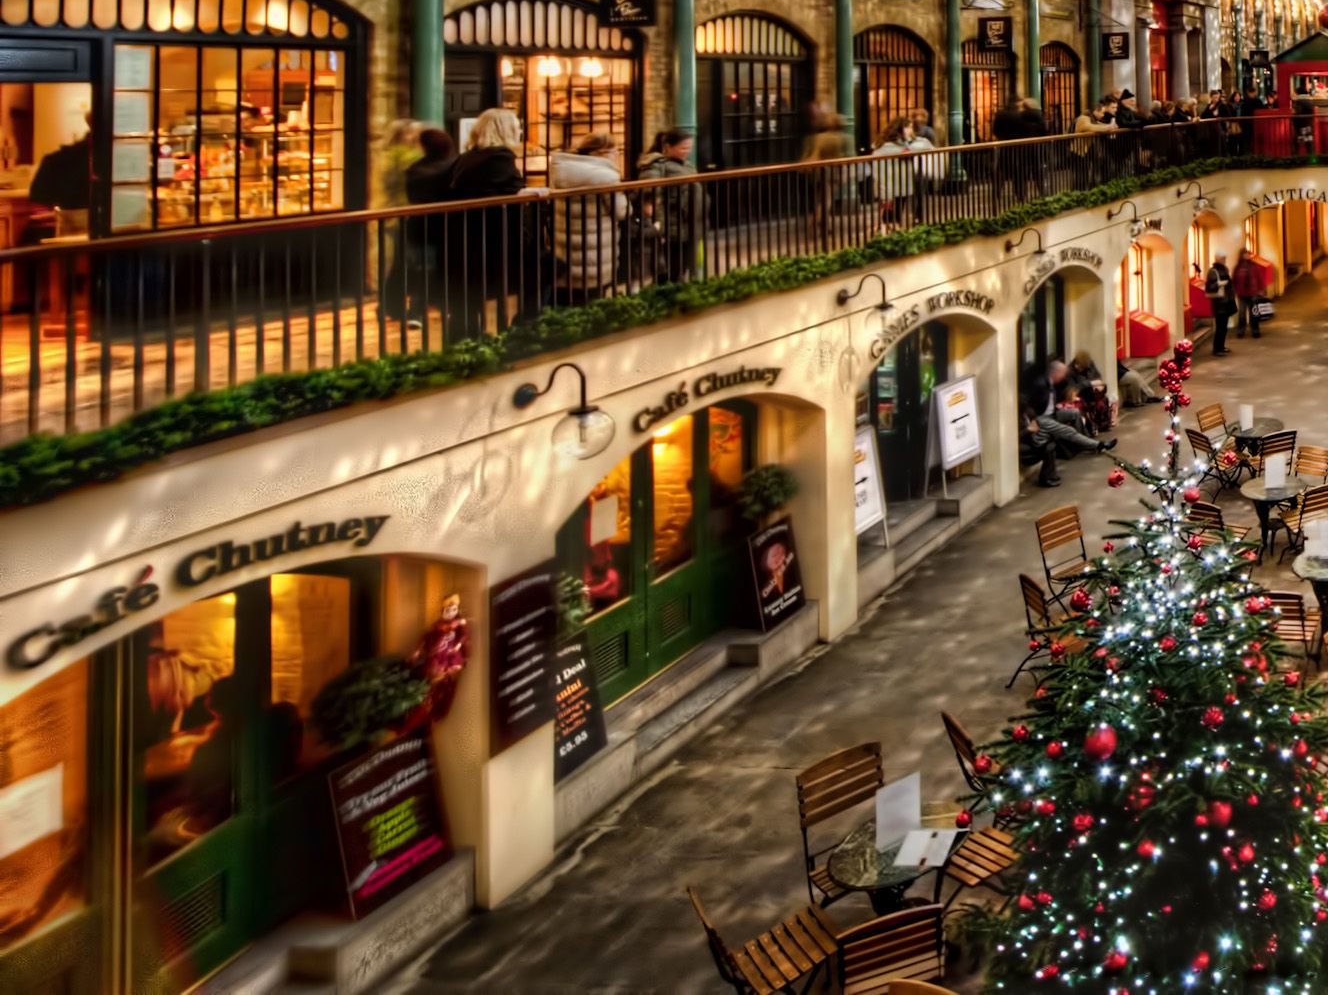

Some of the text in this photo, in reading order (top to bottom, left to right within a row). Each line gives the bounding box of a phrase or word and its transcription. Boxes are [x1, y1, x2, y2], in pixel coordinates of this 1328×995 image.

[925, 288, 996, 316] WORKSHOP
[632, 365, 782, 433] Café Chutney
[1, 513, 391, 673] Café Chutney
